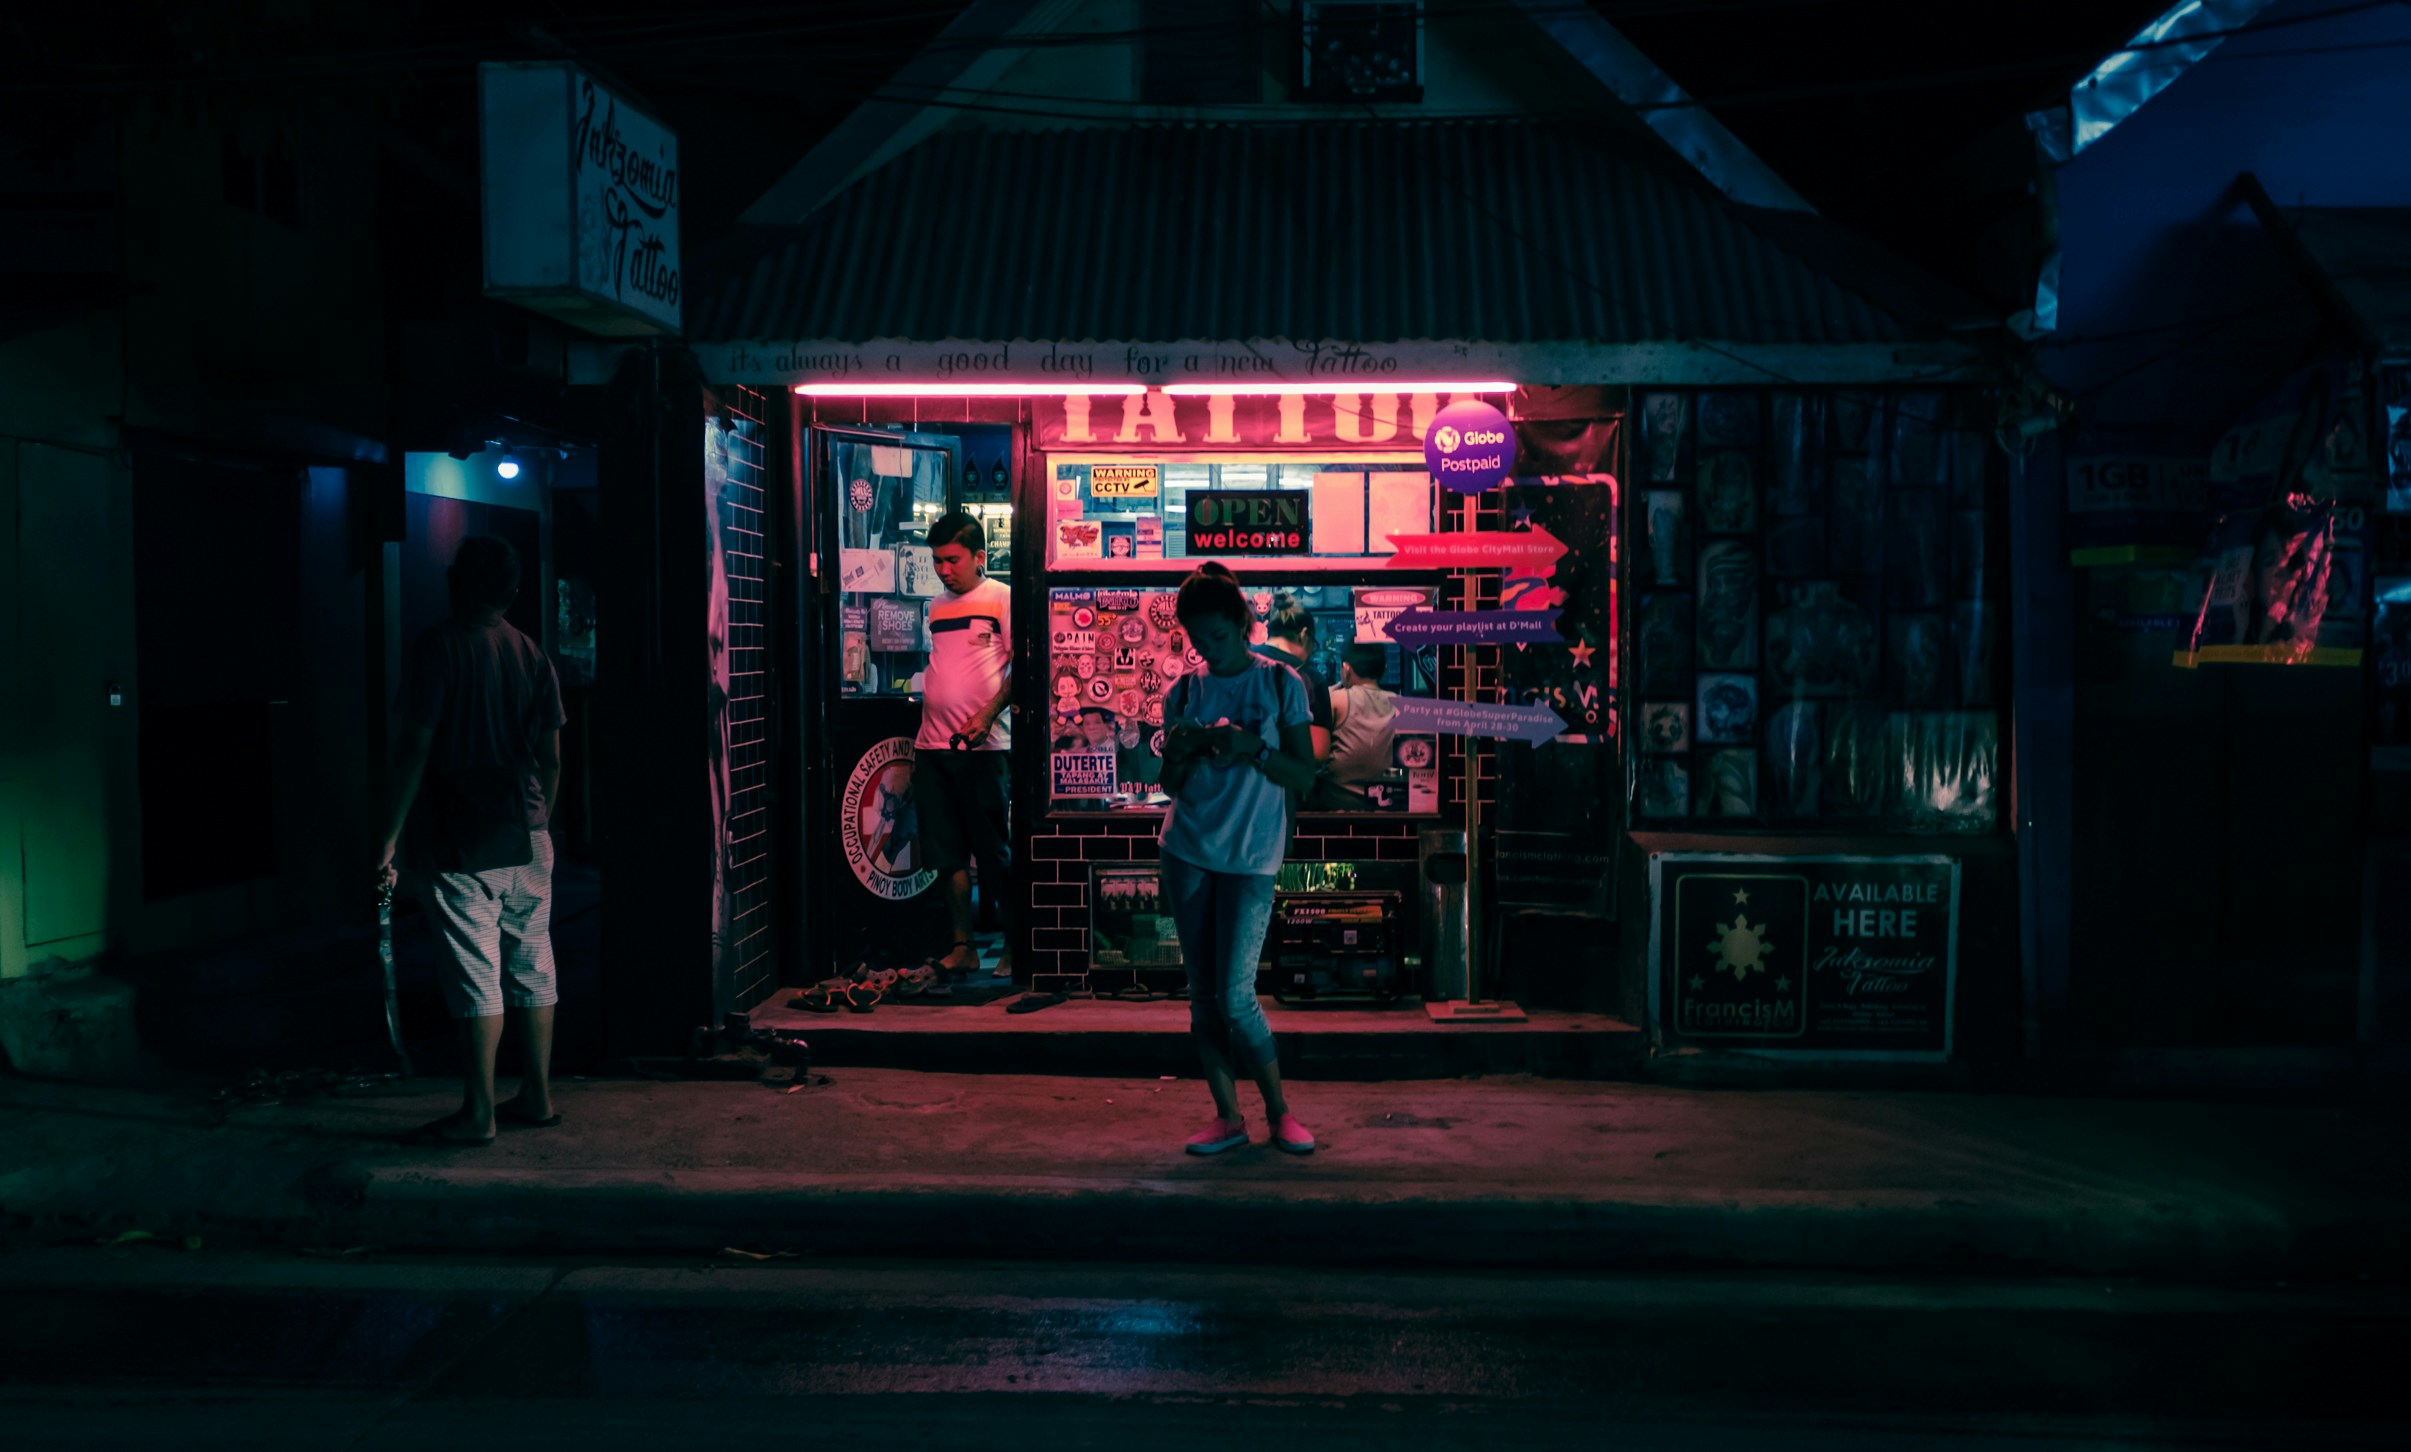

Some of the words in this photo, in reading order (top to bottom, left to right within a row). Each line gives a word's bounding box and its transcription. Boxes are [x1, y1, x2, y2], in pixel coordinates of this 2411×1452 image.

[605, 187, 679, 305] Tattoo
[775, 346, 863, 379] always
[886, 353, 902, 372] a
[938, 344, 1010, 380] good
[1041, 344, 1093, 380] day
[1124, 345, 1168, 375] for
[1184, 353, 1199, 372] a
[1220, 353, 1274, 373] new
[1291, 340, 1398, 376] Tattoo
[1464, 430, 1505, 446] Globe
[1094, 468, 1156, 478] WARNING
[1441, 454, 1501, 474] Postpaid
[2078, 461, 2151, 491] 1GB
[1095, 482, 1130, 493] CCTV
[1193, 498, 1301, 527] OPEN
[1193, 527, 1301, 549] welcome
[1404, 544, 1427, 555] Visit
[1430, 544, 1447, 555] the
[1450, 544, 1479, 555] Globe
[1482, 543, 1524, 557] CityMall
[1527, 544, 1554, 555] Store
[1369, 594, 1418, 603] WARNING
[878, 610, 915, 622] REMOVE
[882, 620, 913, 631] SHOES
[1395, 623, 1428, 633] Create
[1430, 623, 1454, 634] your
[1456, 621, 1494, 634] playlist
[1496, 621, 1507, 631] at
[1509, 620, 1542, 631] D'Mall
[1404, 704, 1431, 716] Party
[1433, 706, 1443, 716] at
[1446, 706, 1554, 723] #GlobeSuperParadise
[1437, 717, 1461, 728] from
[1464, 718, 1488, 730] April
[1490, 721, 1519, 732] 28-30
[1054, 755, 1114, 771] DUTERTE
[1065, 785, 1113, 794] PRESIDENT
[843, 775, 866, 865] OCCUPATIONAL
[860, 743, 891, 776] SAFETY
[892, 739, 910, 757] AND
[867, 870, 892, 897] PINOY
[891, 876, 912, 897] BODY
[1813, 882, 1939, 903] AVAILABLE
[1833, 908, 1917, 938] HERE
[1840, 969, 1909, 996] Tattoo
[1683, 997, 1795, 1018] FrancisM
